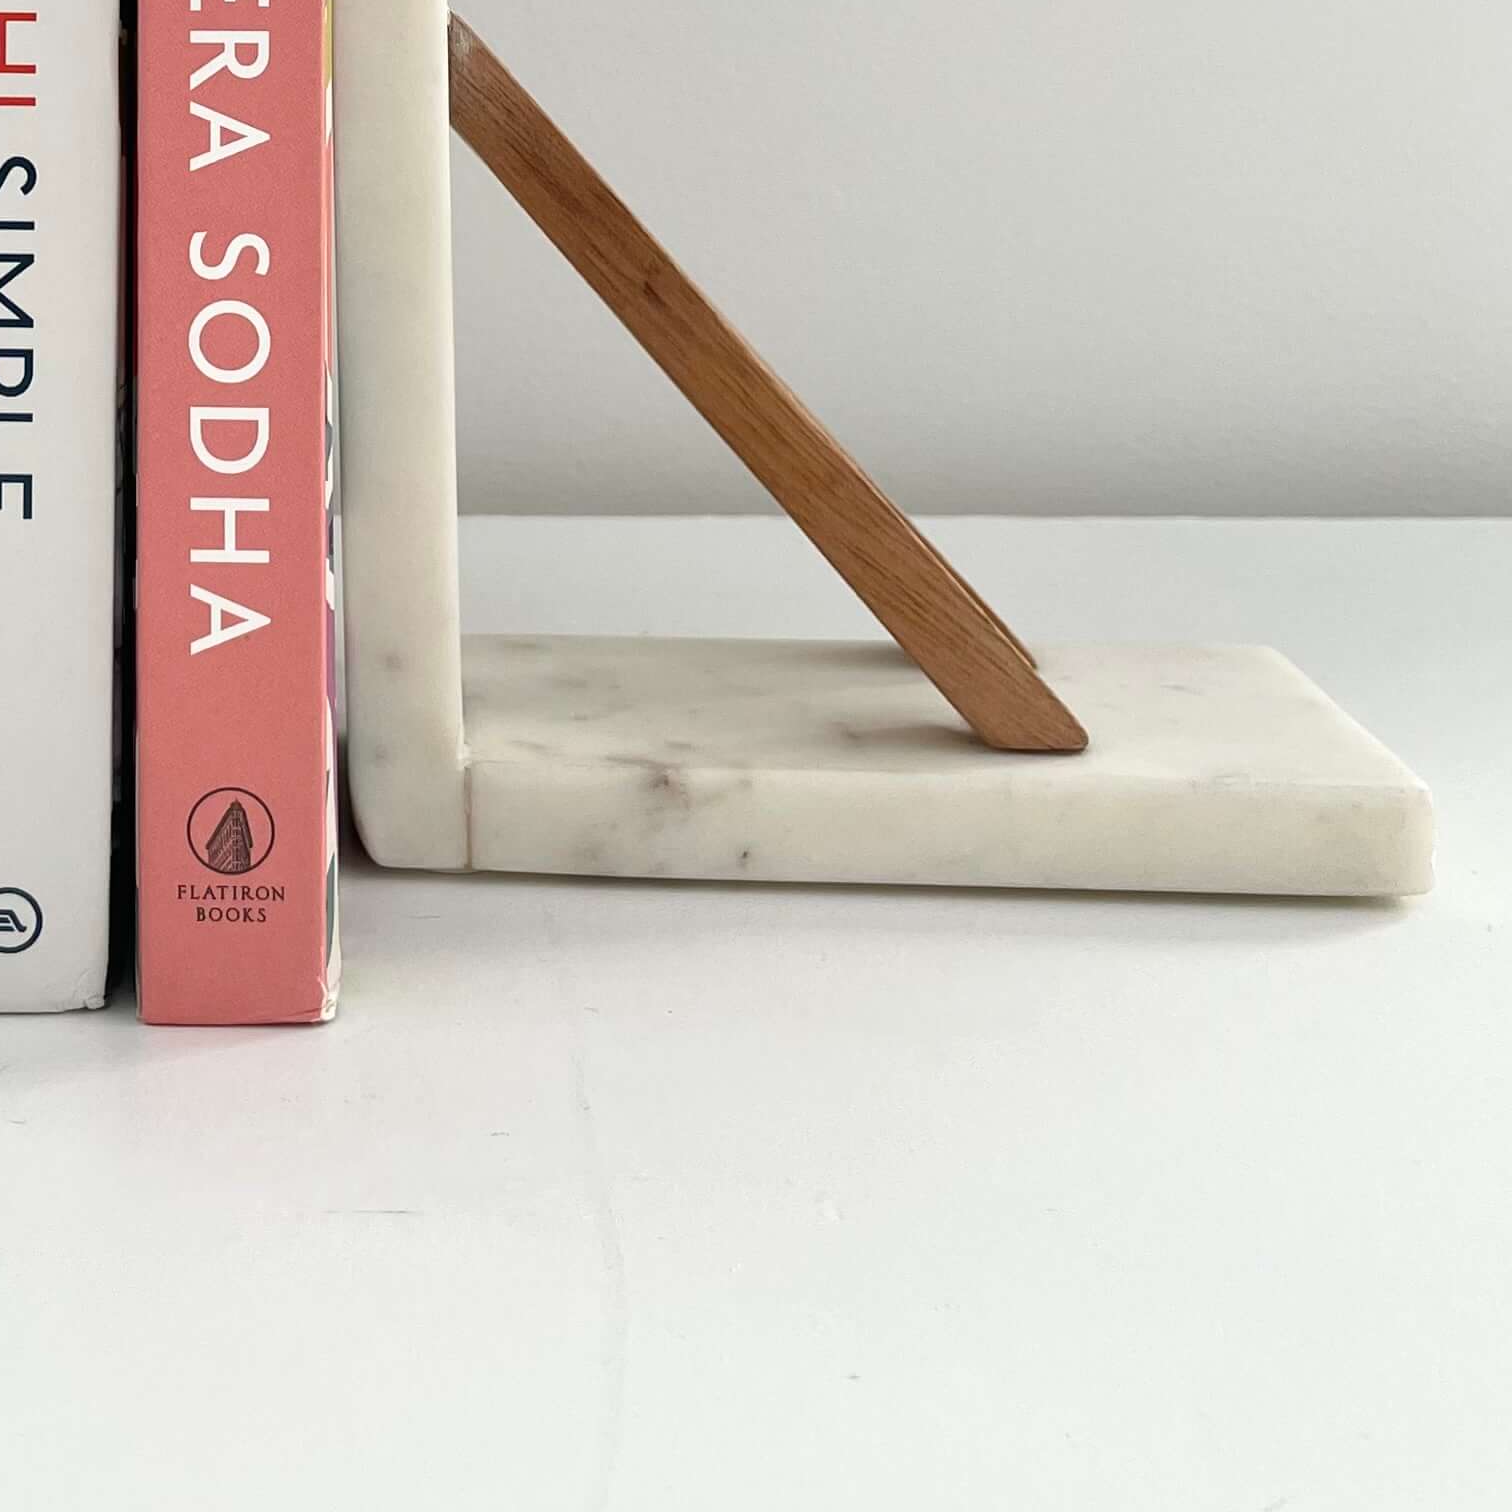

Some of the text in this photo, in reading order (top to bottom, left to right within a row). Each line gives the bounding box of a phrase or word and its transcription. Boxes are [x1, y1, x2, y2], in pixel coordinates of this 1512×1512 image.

[188, 231, 272, 656] SODHA
[177, 884, 285, 902] FLATIRON
[195, 906, 267, 924] BOOKS
